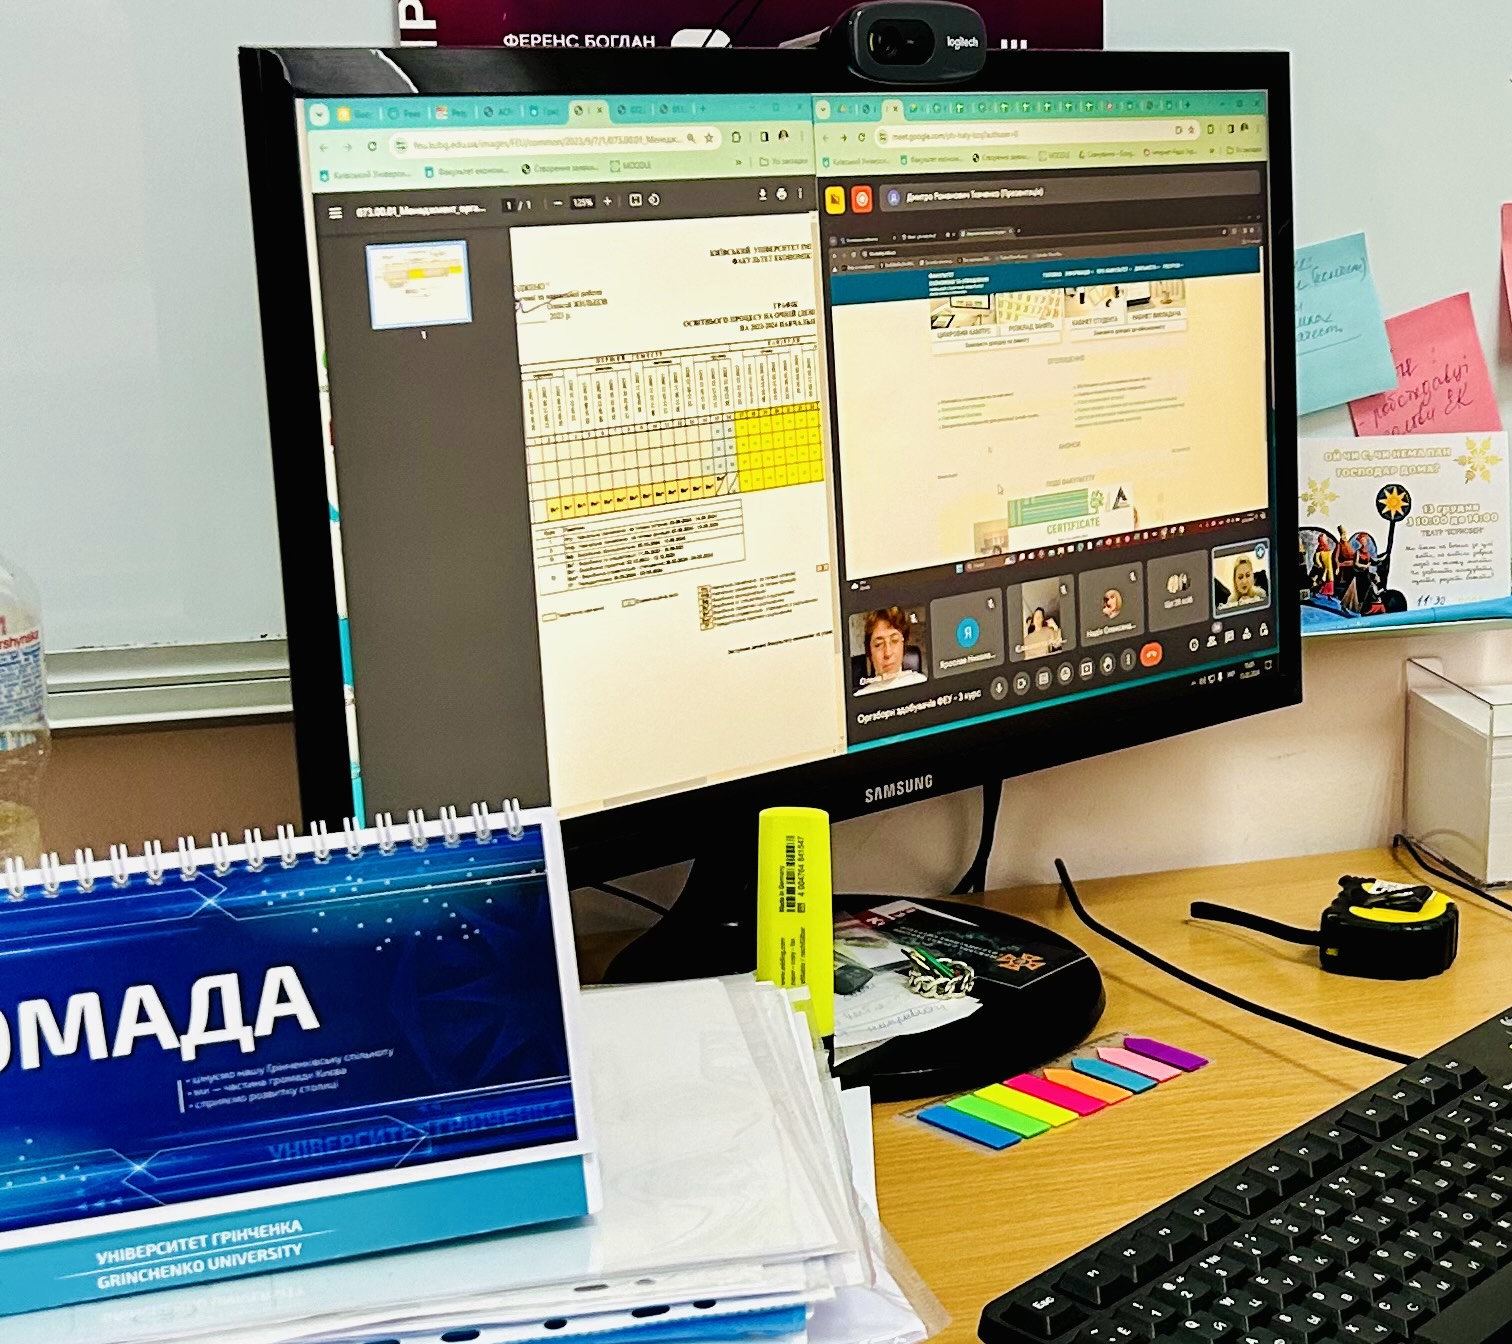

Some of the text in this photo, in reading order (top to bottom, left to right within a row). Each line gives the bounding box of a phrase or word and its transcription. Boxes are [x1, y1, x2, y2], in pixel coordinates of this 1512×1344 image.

[503, 33, 579, 48] ФЕРЕНС
[947, 36, 978, 50] logitech
[1392, 448, 1426, 460] НЕМА
[1428, 447, 1452, 458] ПАН
[1336, 465, 1397, 477] ГОСПОДАР
[1423, 504, 1480, 516] 13 грудня
[1047, 517, 1100, 535] CERTIFICATE
[1416, 515, 1448, 526] 10:00
[1467, 512, 1499, 524] 14:00
[964, 626, 972, 638] Я
[865, 774, 934, 803] SAMSUNG
[779, 866, 787, 889] Germany
[95, 1217, 303, 1265] УНІВЕРСИТЕТ ГРІНЧЕНКА
[97, 1241, 303, 1290] GRINCHENKO UNIVERSITY
[1032, 1294, 1055, 1310] Esc
